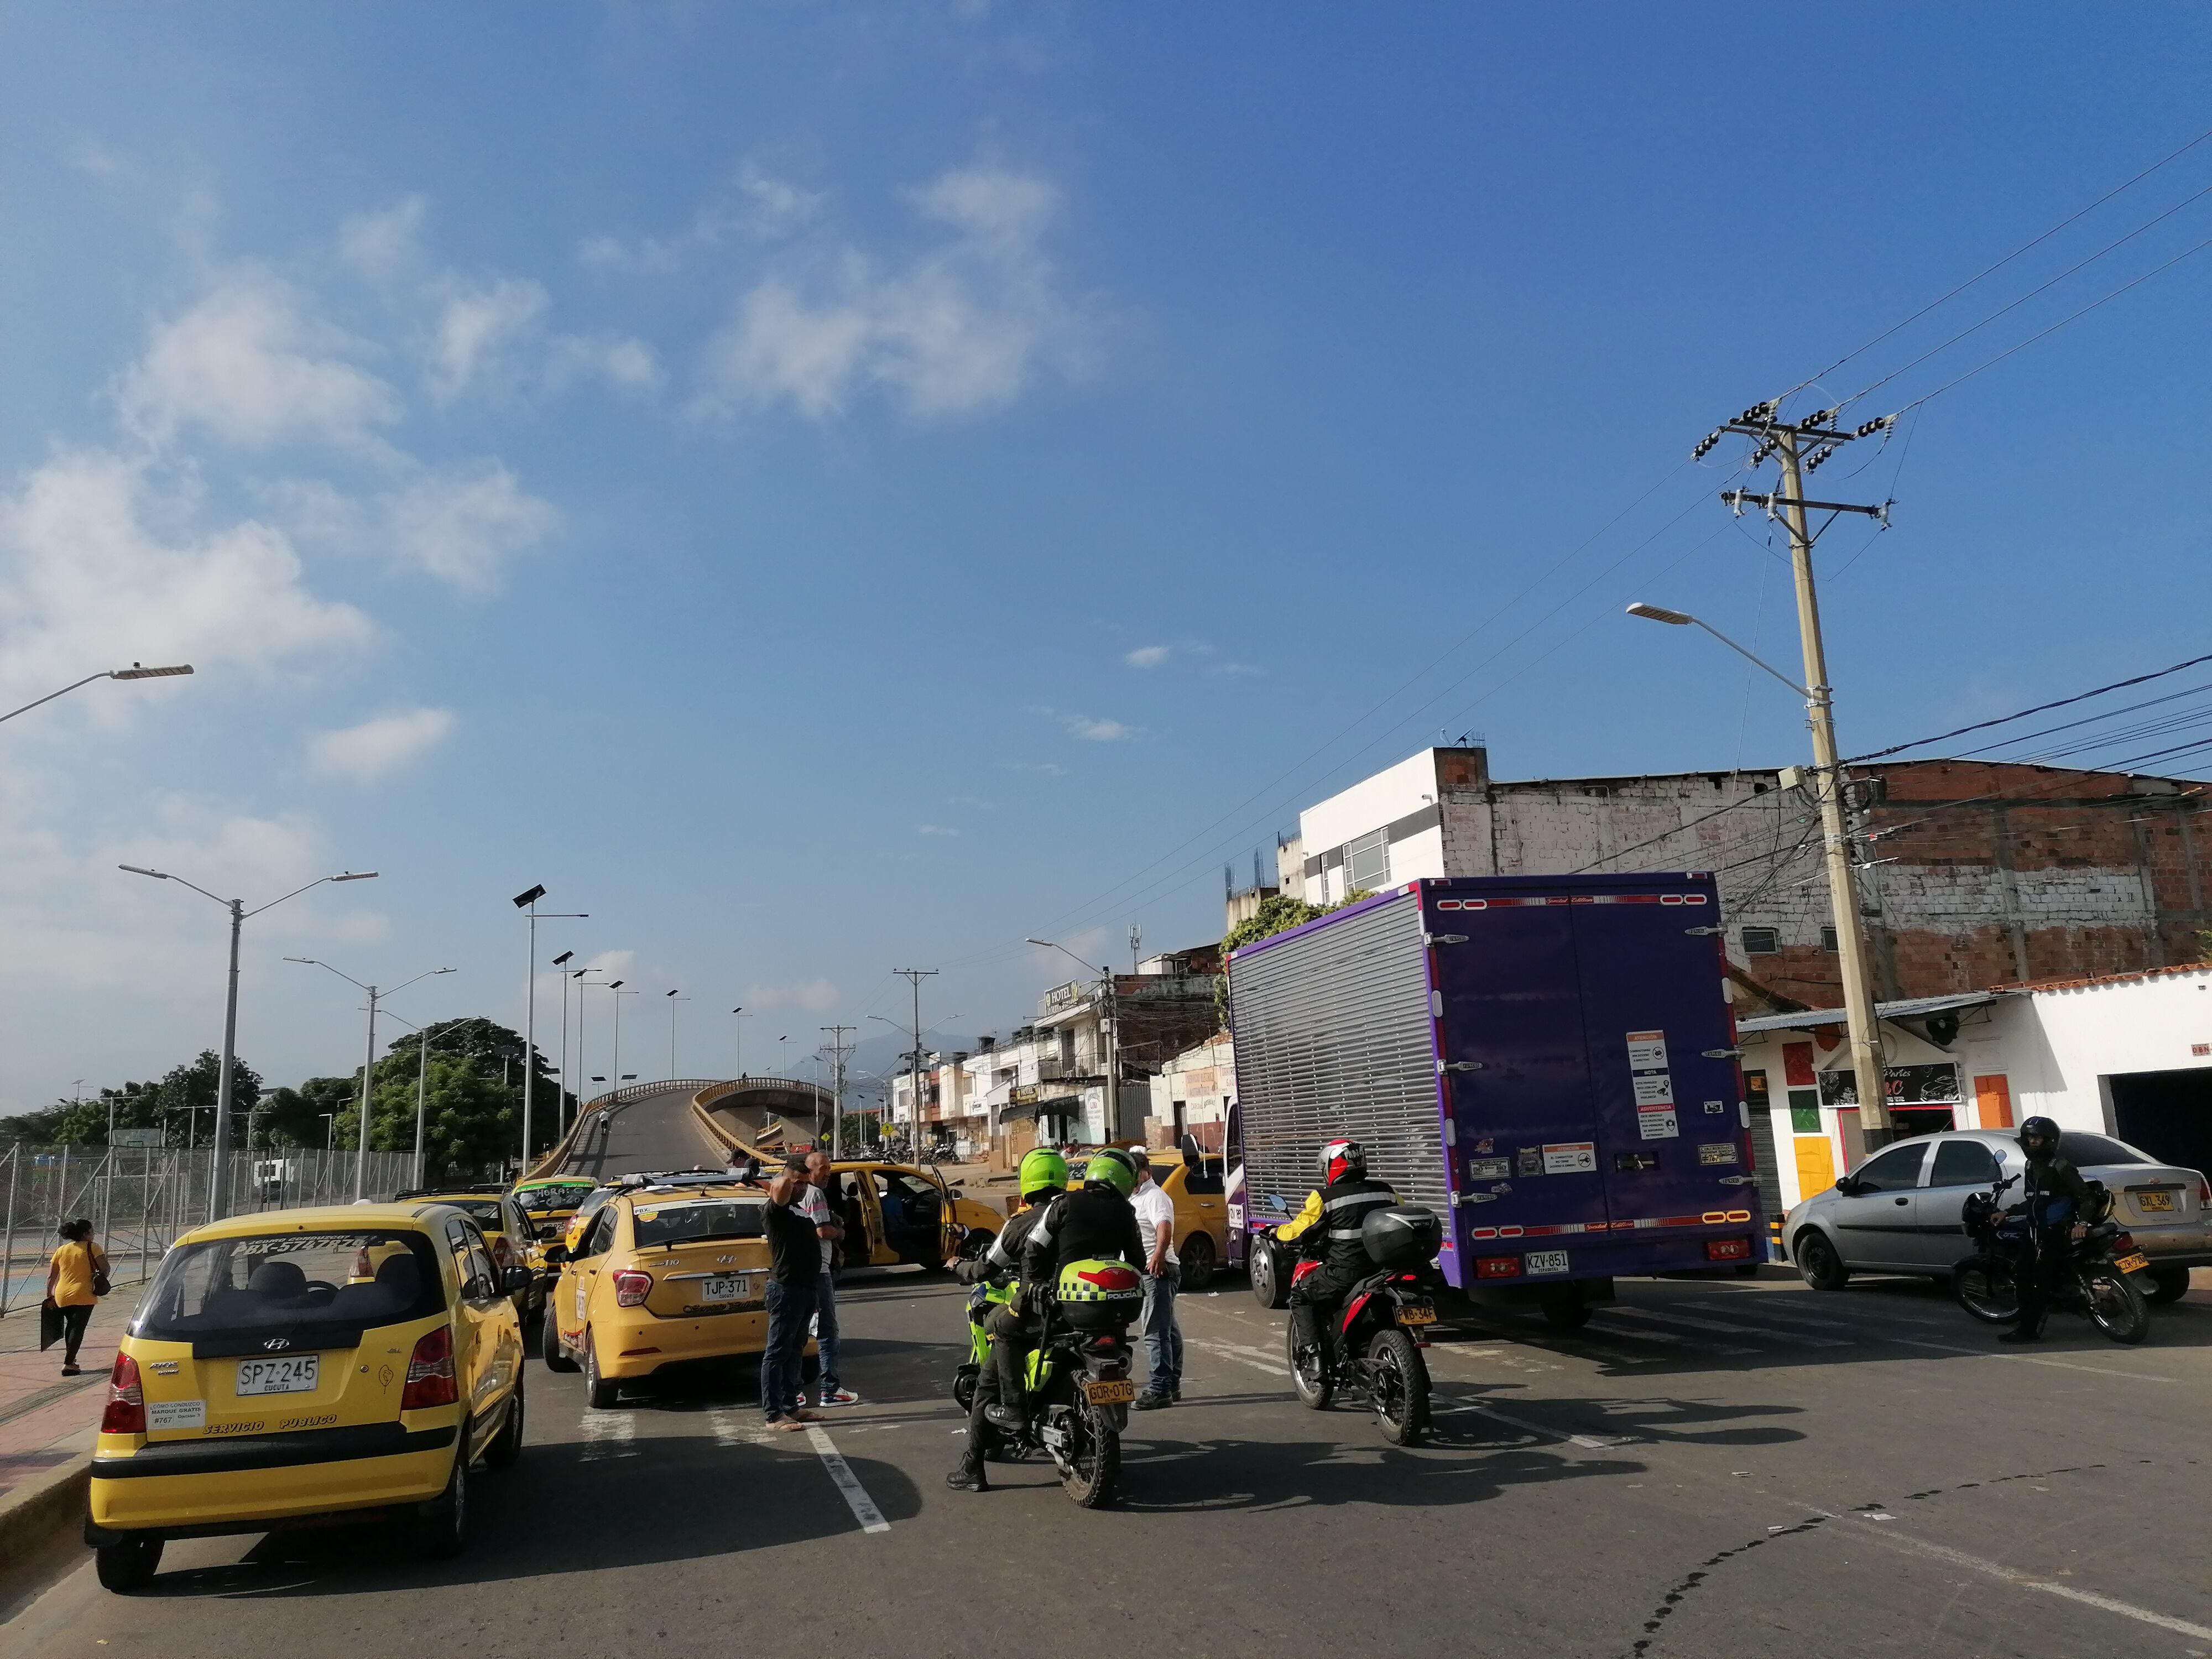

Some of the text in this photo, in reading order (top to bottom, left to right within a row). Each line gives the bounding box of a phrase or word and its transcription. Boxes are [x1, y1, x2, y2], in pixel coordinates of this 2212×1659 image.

[1051, 987, 1071, 1003] HOTEL
[1884, 1068, 1911, 1077] Partes
[203, 1414, 337, 1434] SERVICIO PUBLICO
